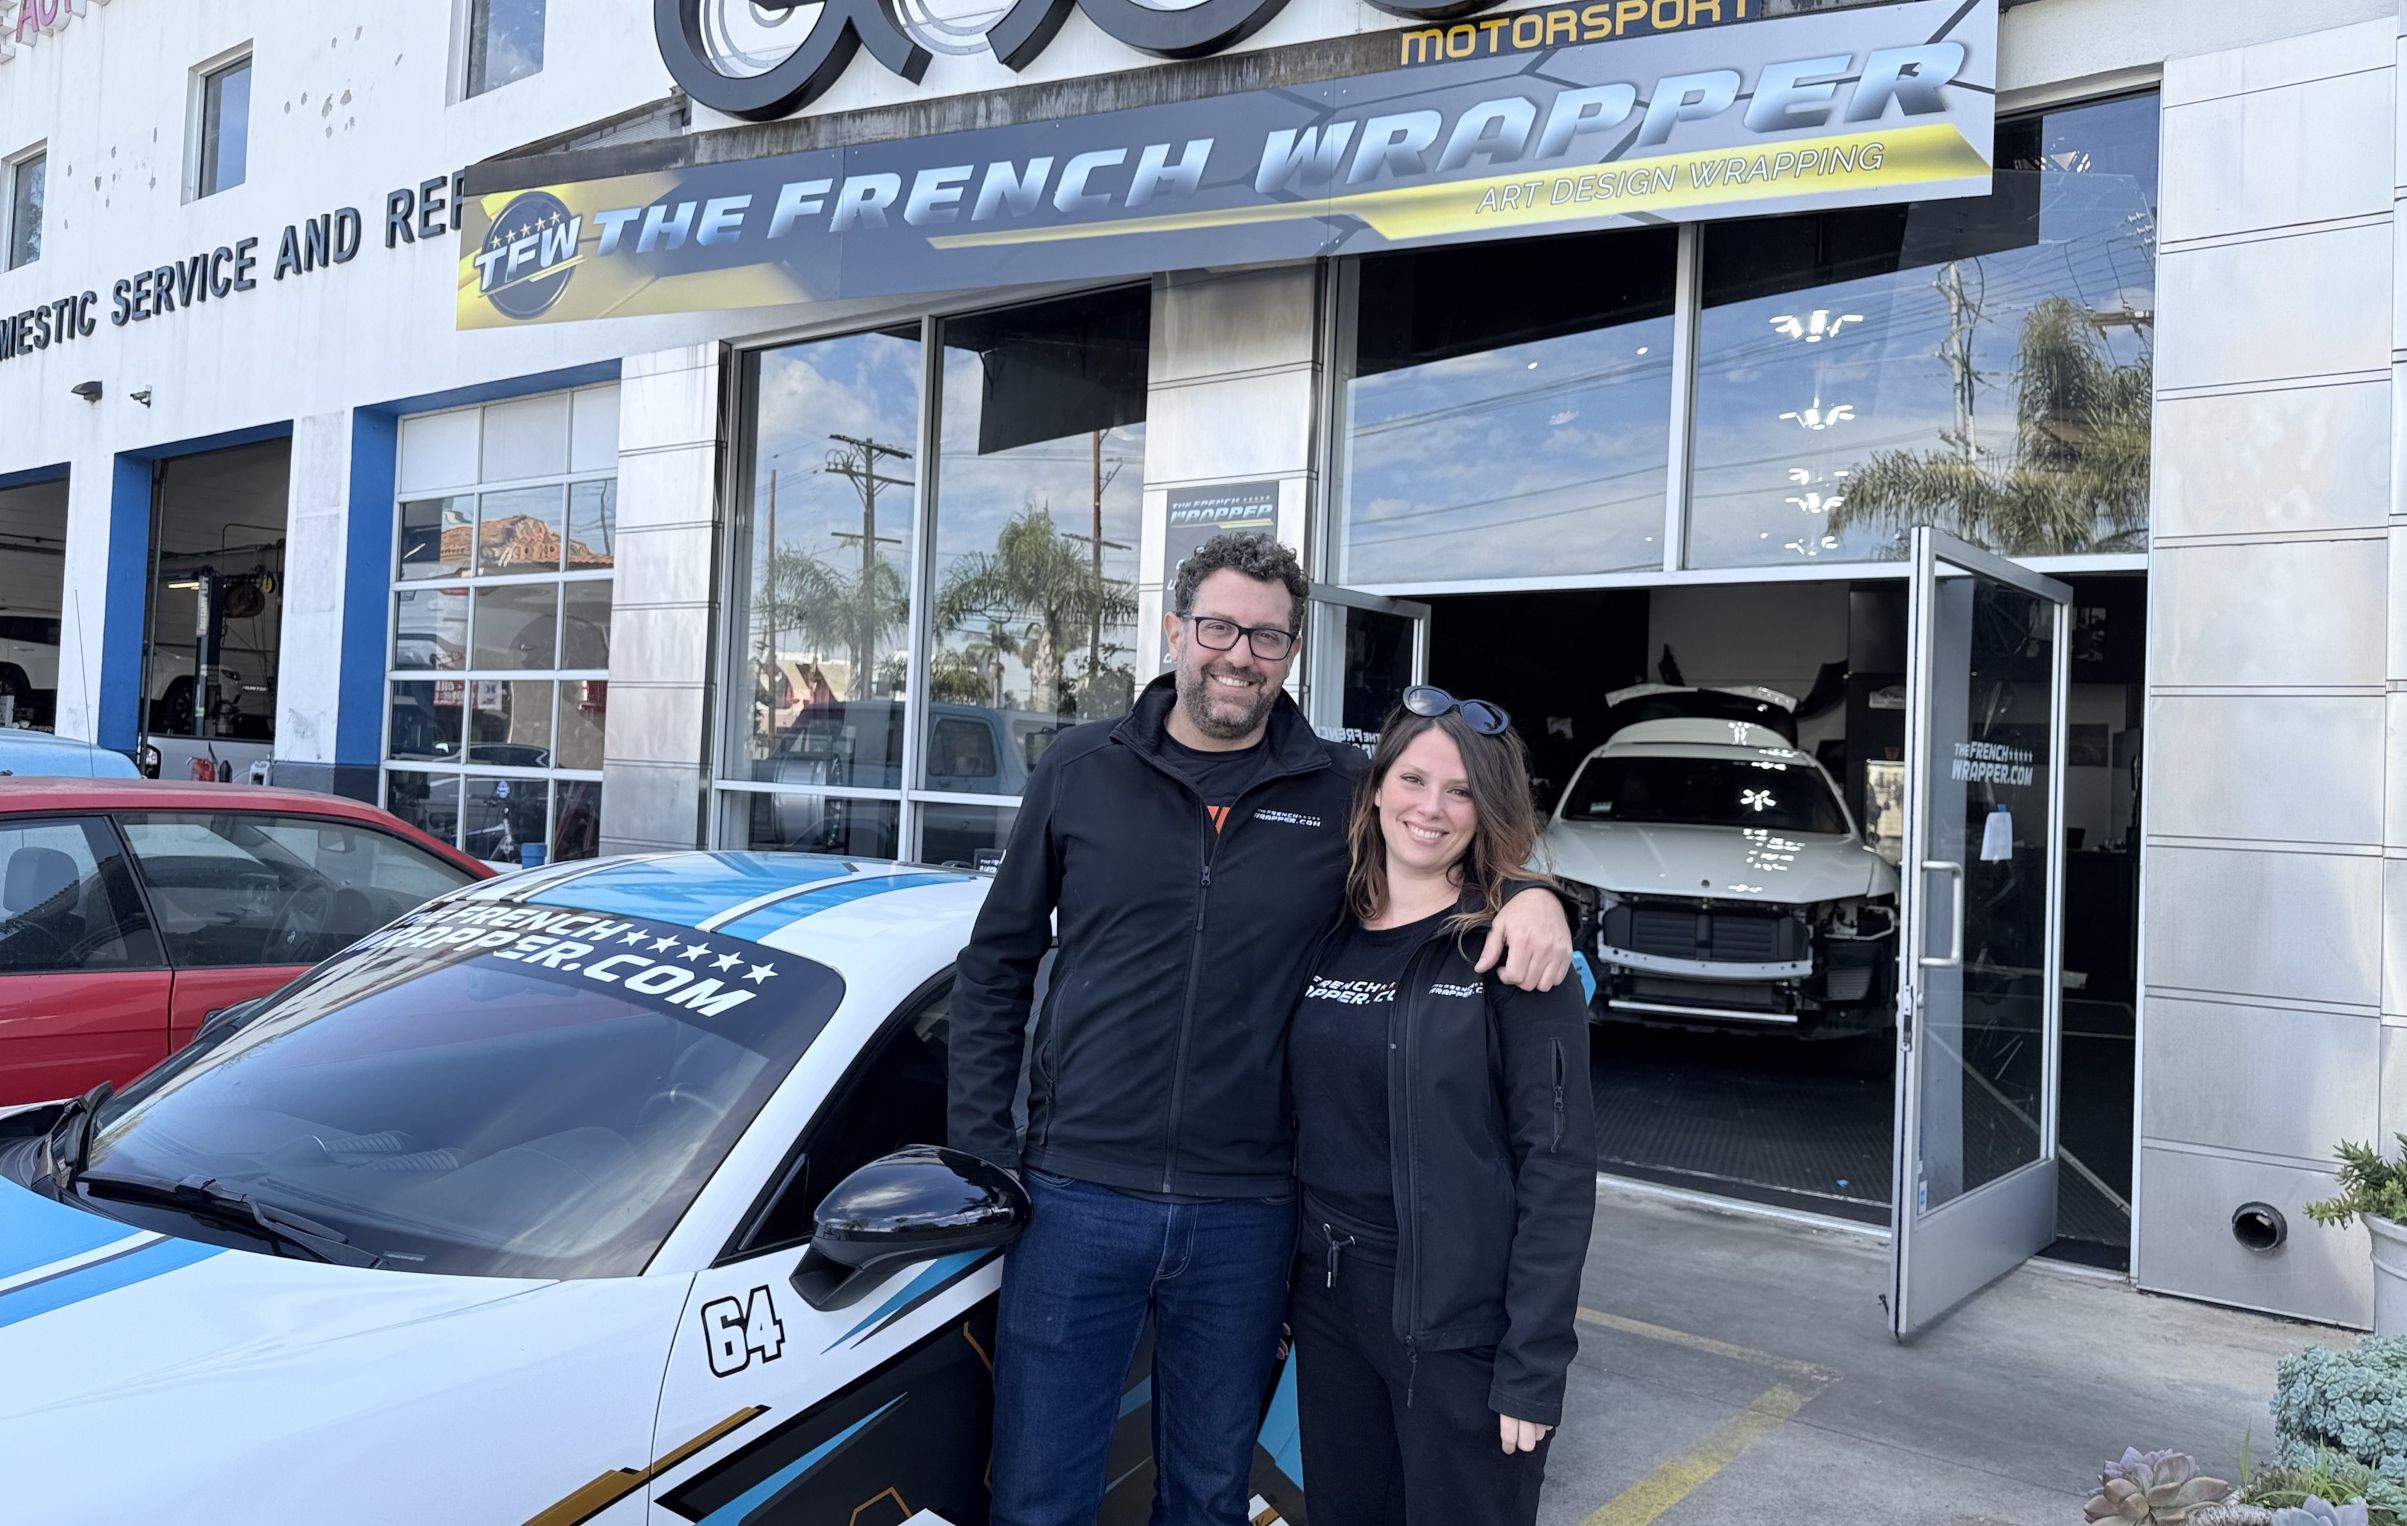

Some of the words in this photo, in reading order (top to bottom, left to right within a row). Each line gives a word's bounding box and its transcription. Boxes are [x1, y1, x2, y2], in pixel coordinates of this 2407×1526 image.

[593, 195, 751, 256] THE
[768, 138, 1214, 240] FRENCH
[1255, 42, 1967, 195] WRAPPER
[1475, 181, 1544, 214] ART
[1551, 163, 1678, 205] DESIGN
[1690, 142, 1884, 189] WRAPPING
[111, 237, 258, 327] SERVICE
[273, 206, 361, 280] AND
[474, 215, 582, 291] TFW
[1170, 504, 1273, 524] WRAPPER
[1193, 497, 1240, 508] FRENCH
[1954, 742, 1970, 757] THE
[1970, 741, 2009, 762] FRENCH
[1951, 759, 2034, 786] WRAPPER.COM
[1254, 812, 1321, 827] WRAPPER.COM
[1266, 809, 1299, 819] FRENCH
[437, 906, 635, 944] FRENCH
[701, 1284, 785, 1378] 64
